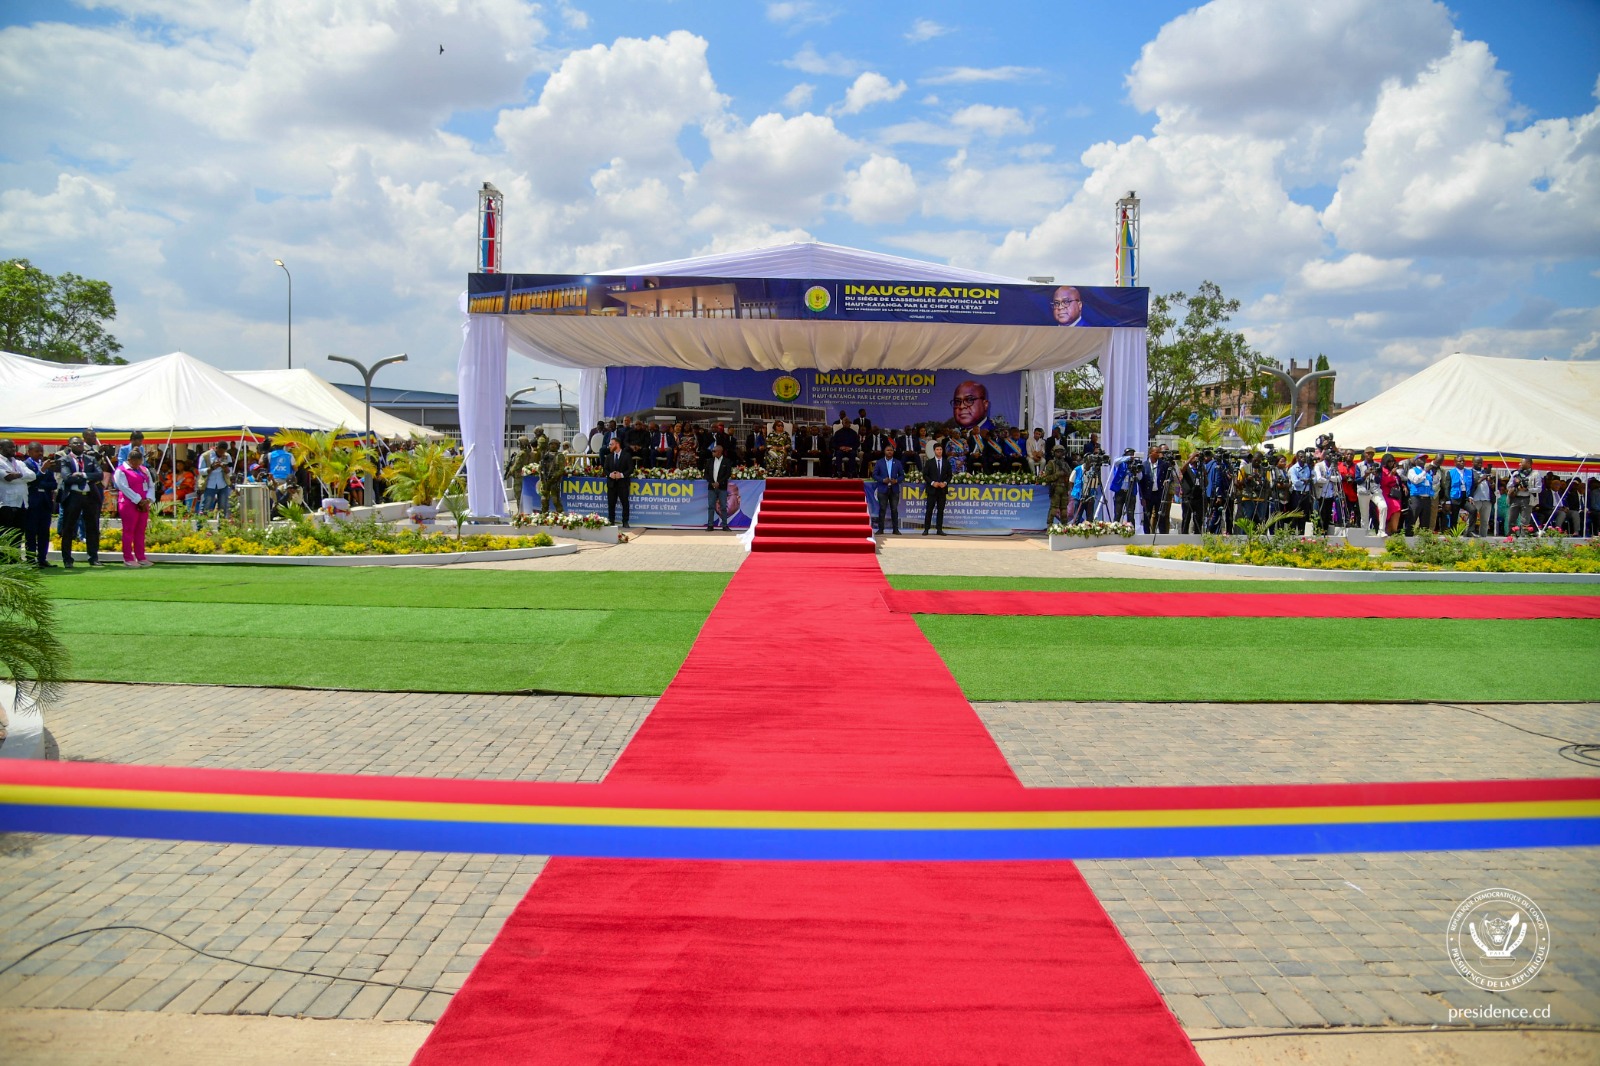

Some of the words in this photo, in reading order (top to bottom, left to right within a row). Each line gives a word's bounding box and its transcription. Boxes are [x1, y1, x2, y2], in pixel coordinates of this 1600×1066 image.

[844, 285, 1000, 299] INAUGURATION
[815, 373, 935, 386] INAUGURATION
[563, 481, 694, 497] INAURATION
[902, 486, 1034, 501] INAGURATION
[576, 493, 594, 501] SIÈGE
